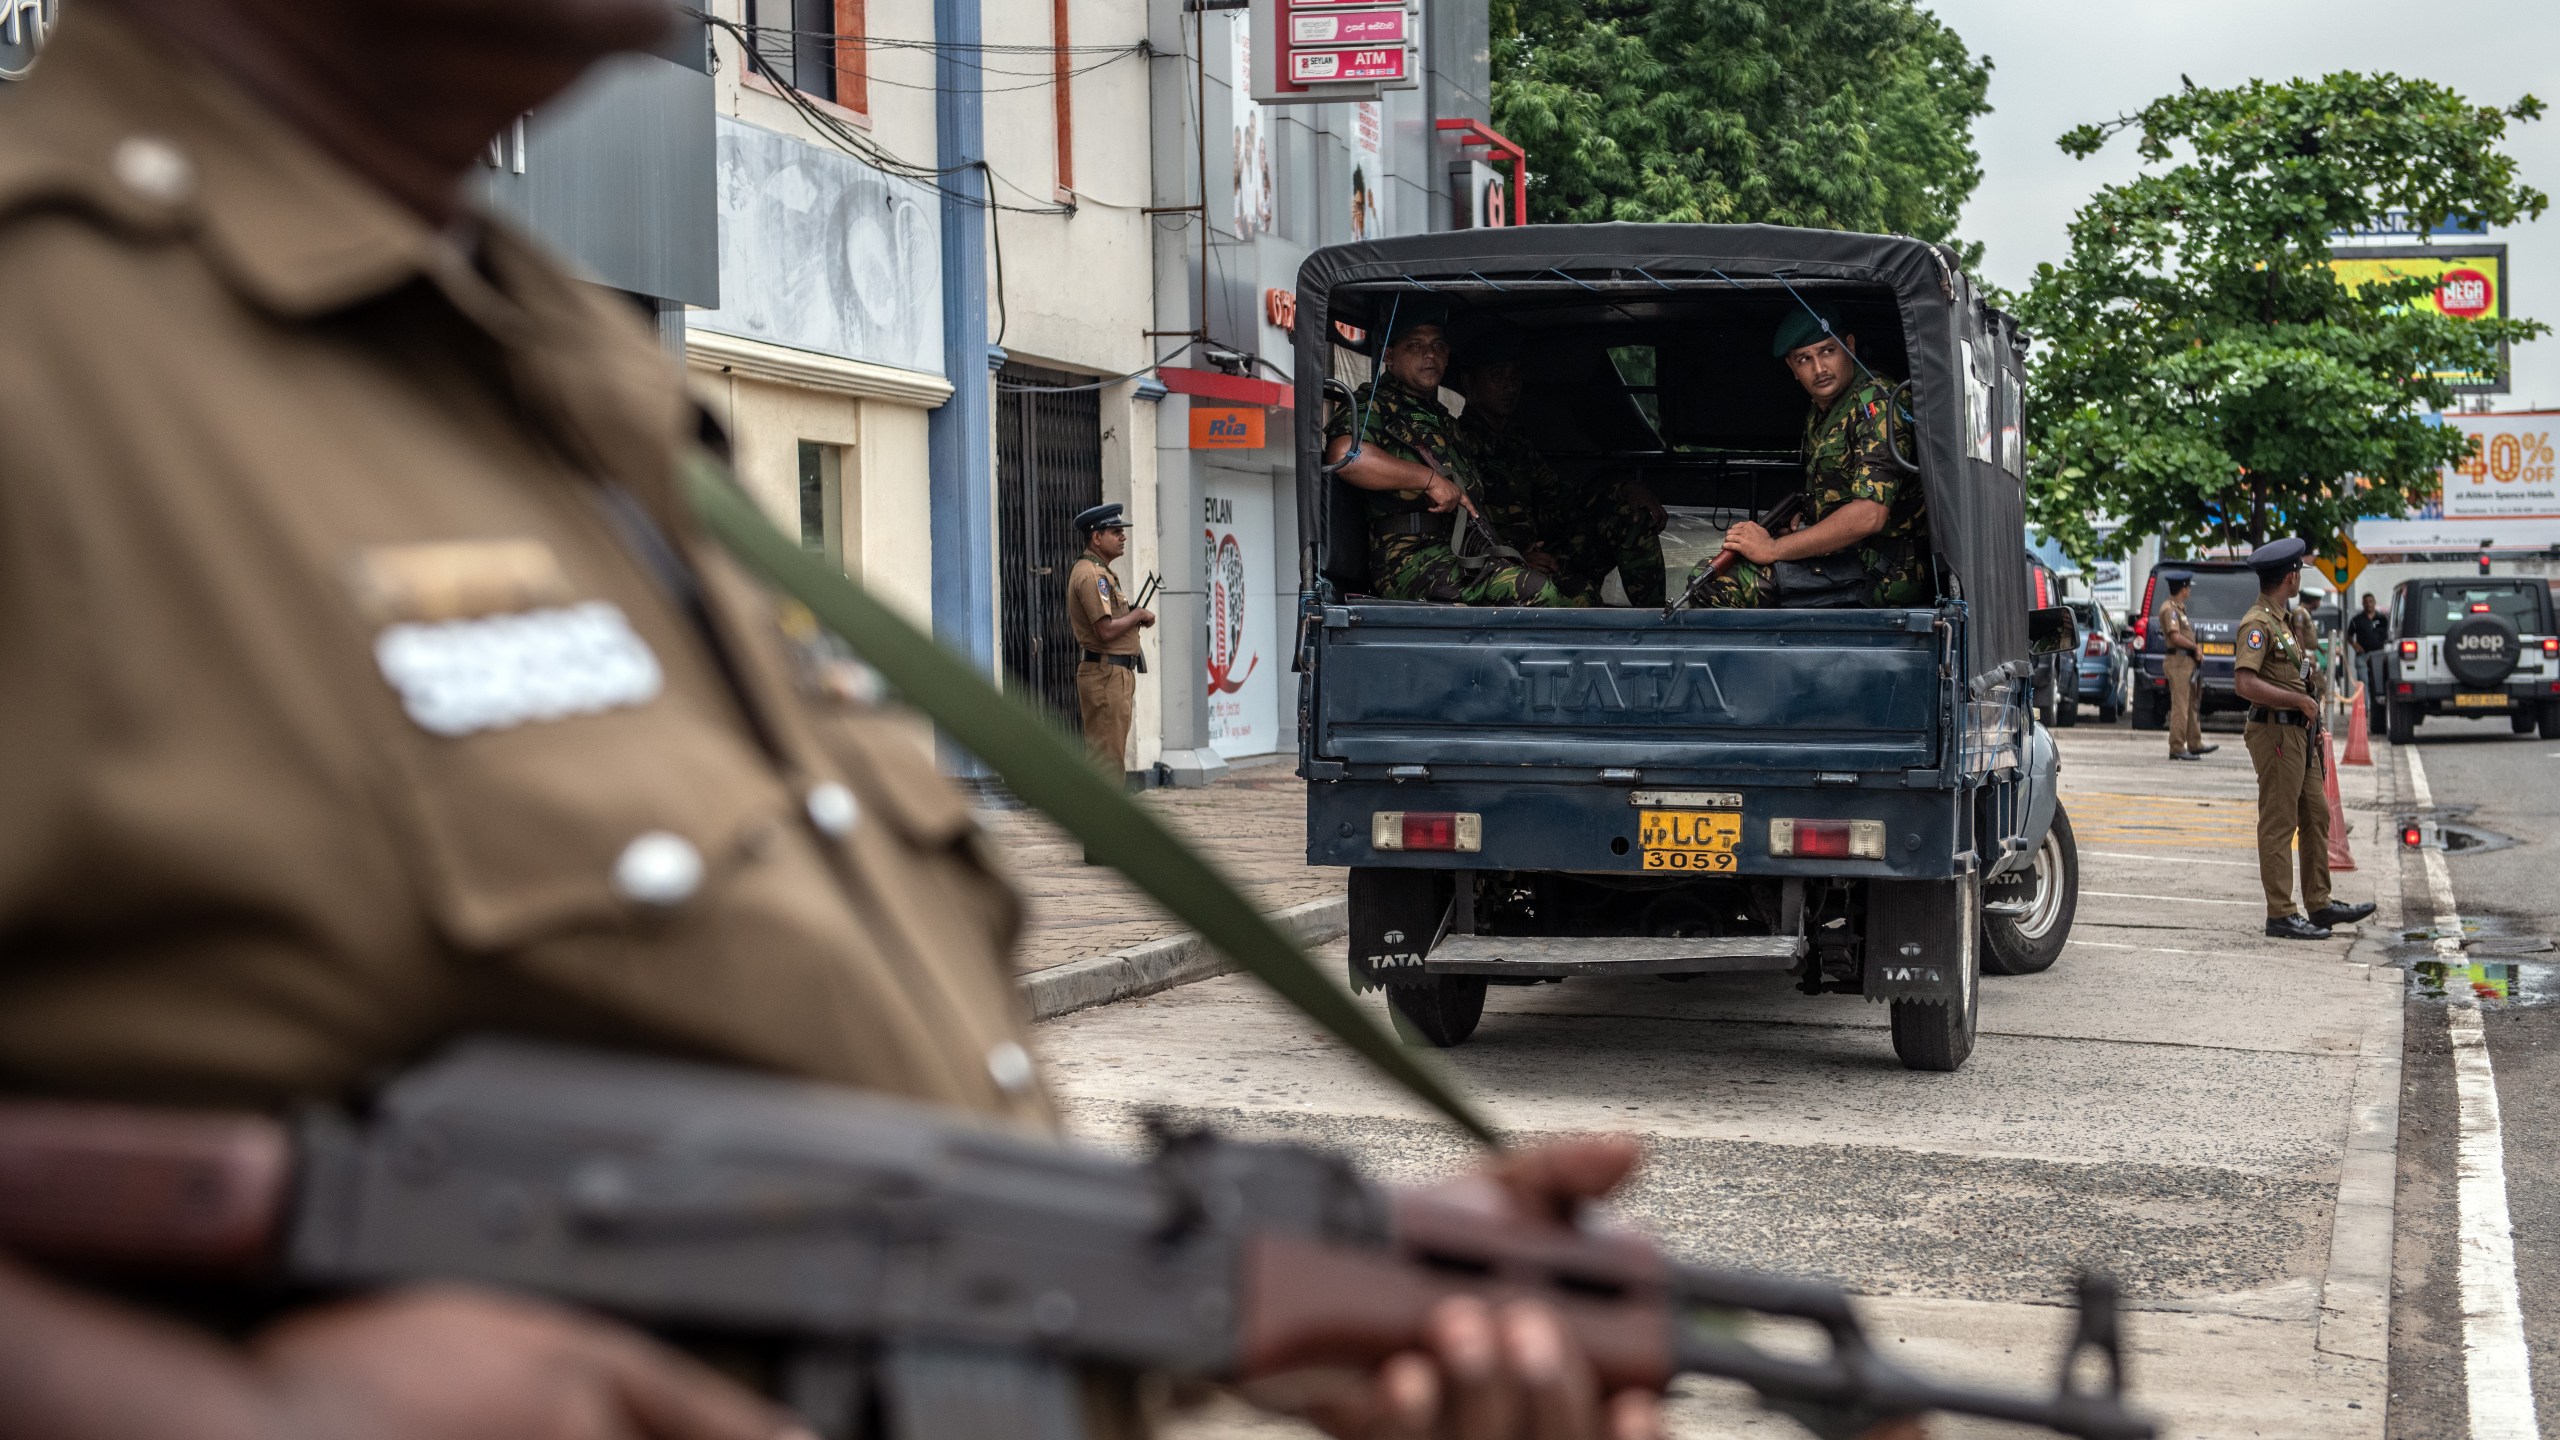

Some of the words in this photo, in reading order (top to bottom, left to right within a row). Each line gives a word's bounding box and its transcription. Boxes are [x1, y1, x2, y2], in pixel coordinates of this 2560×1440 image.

[1310, 56, 1333, 65] SEYLAN
[1354, 51, 1387, 66] ATM
[2443, 280, 2484, 300] MEGA
[1209, 414, 1247, 435] Ria
[2522, 466, 2555, 484] OFF
[1205, 498, 1232, 524] EYLAN
[2194, 622, 2229, 633] POLICE
[2456, 634, 2505, 652] Jeep
[1519, 661, 1727, 711] TATA
[1643, 829, 1666, 845] WP
[1648, 852, 1733, 869] 3059
[1989, 873, 2023, 884] ATA
[1368, 953, 1423, 968] TATA
[1883, 967, 1940, 981] TATA
